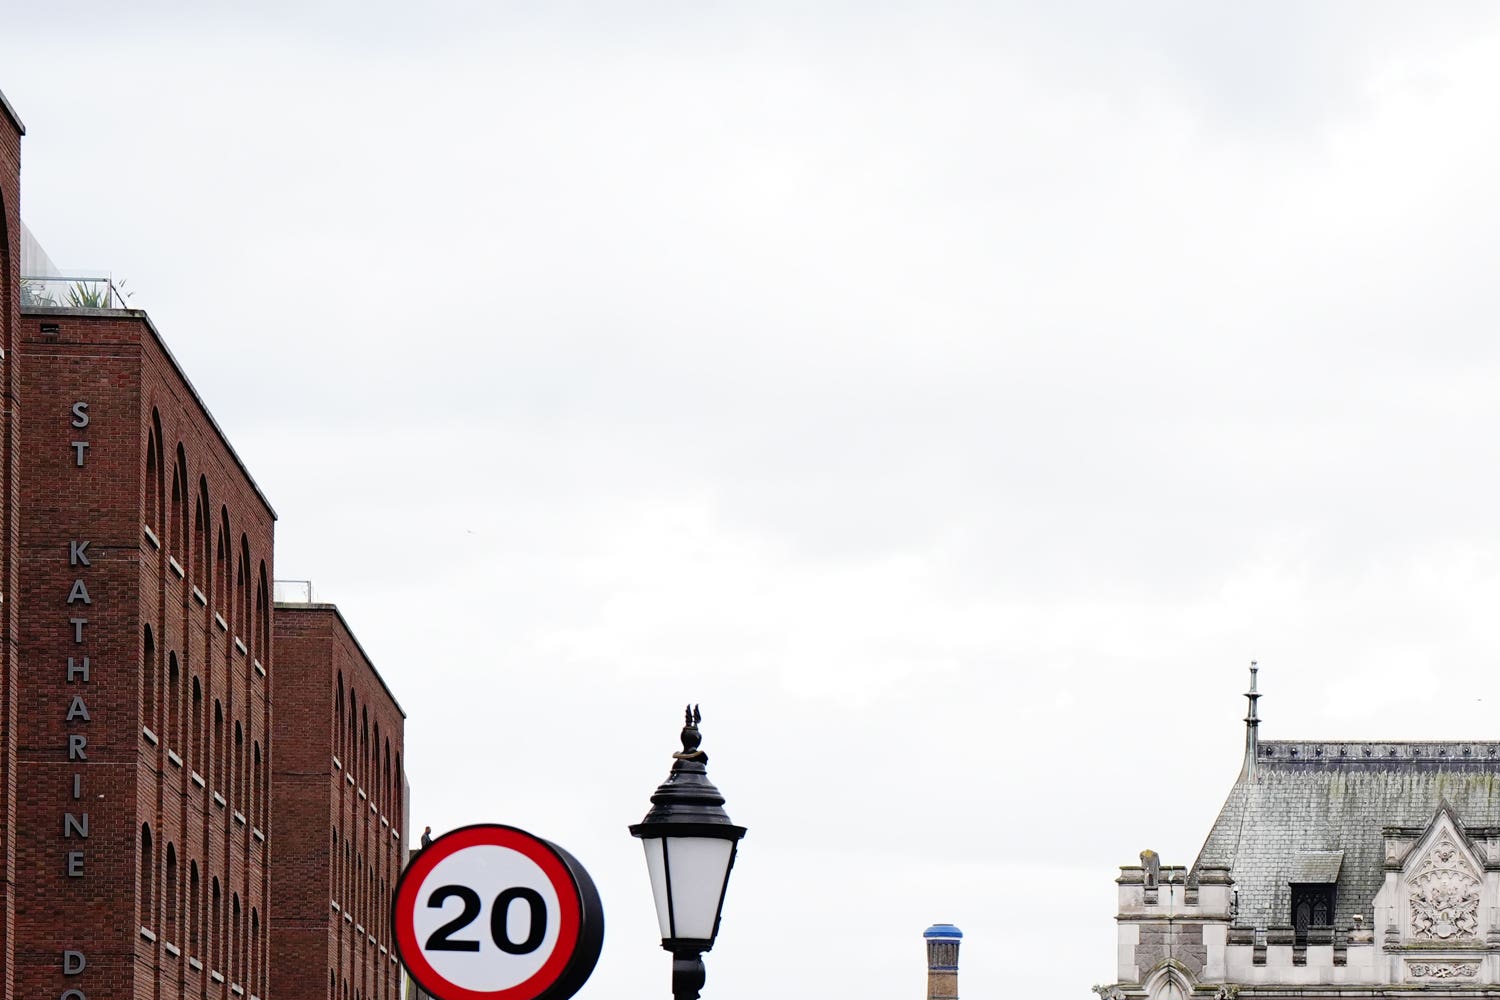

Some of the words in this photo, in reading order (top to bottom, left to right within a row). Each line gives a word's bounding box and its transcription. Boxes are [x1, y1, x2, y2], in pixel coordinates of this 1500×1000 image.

[71, 402, 90, 466] ST
[65, 540, 92, 877] KATHARINE
[425, 884, 548, 954] 20
